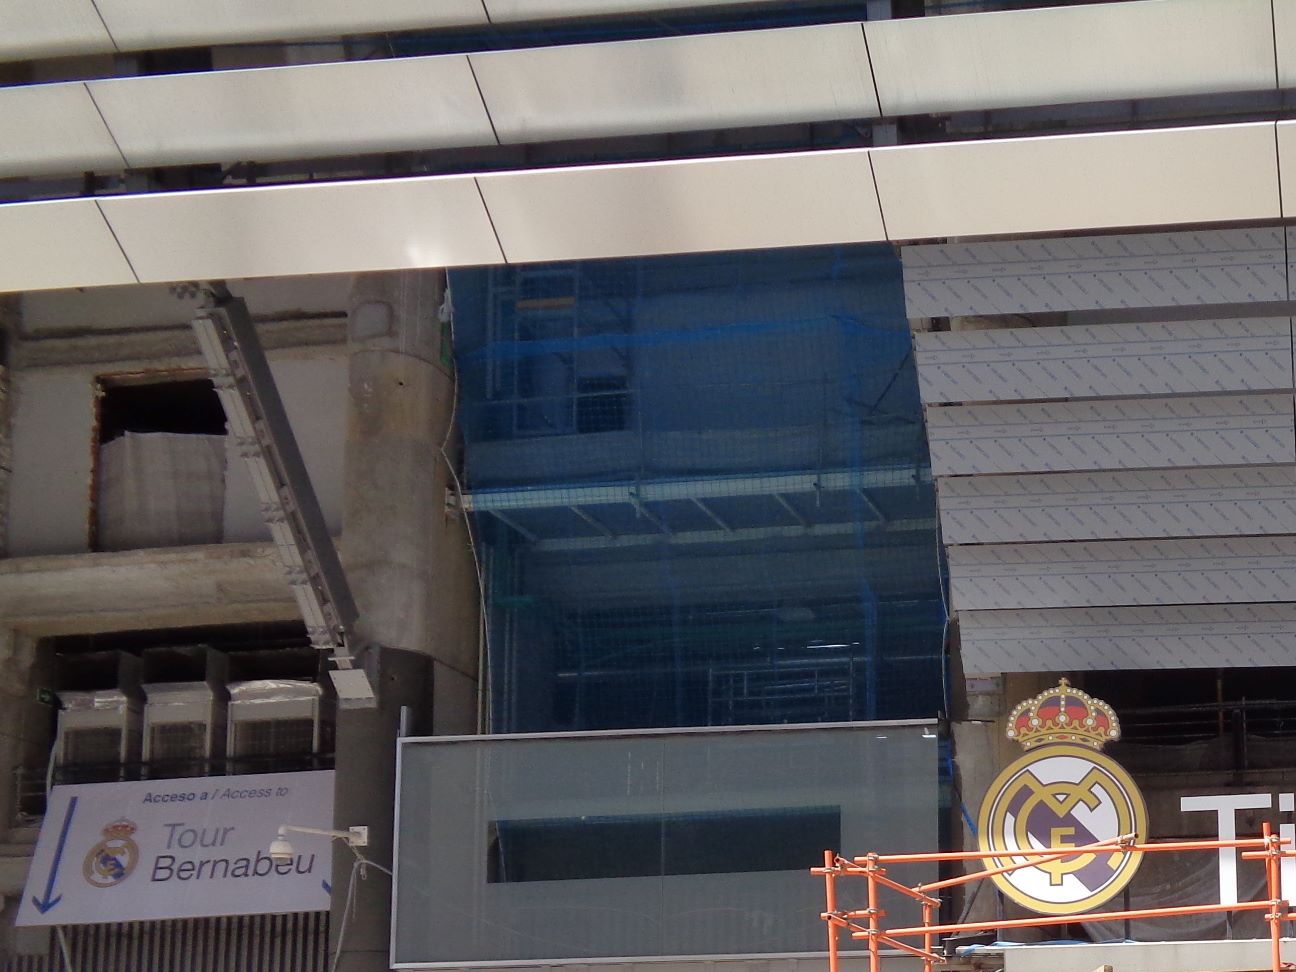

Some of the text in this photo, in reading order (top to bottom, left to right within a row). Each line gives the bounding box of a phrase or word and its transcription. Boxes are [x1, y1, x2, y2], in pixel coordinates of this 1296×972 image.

[143, 792, 195, 804] Acceso
[200, 791, 208, 801] a
[219, 787, 272, 800] Access
[275, 786, 288, 797] to
[164, 822, 235, 849] Tour
